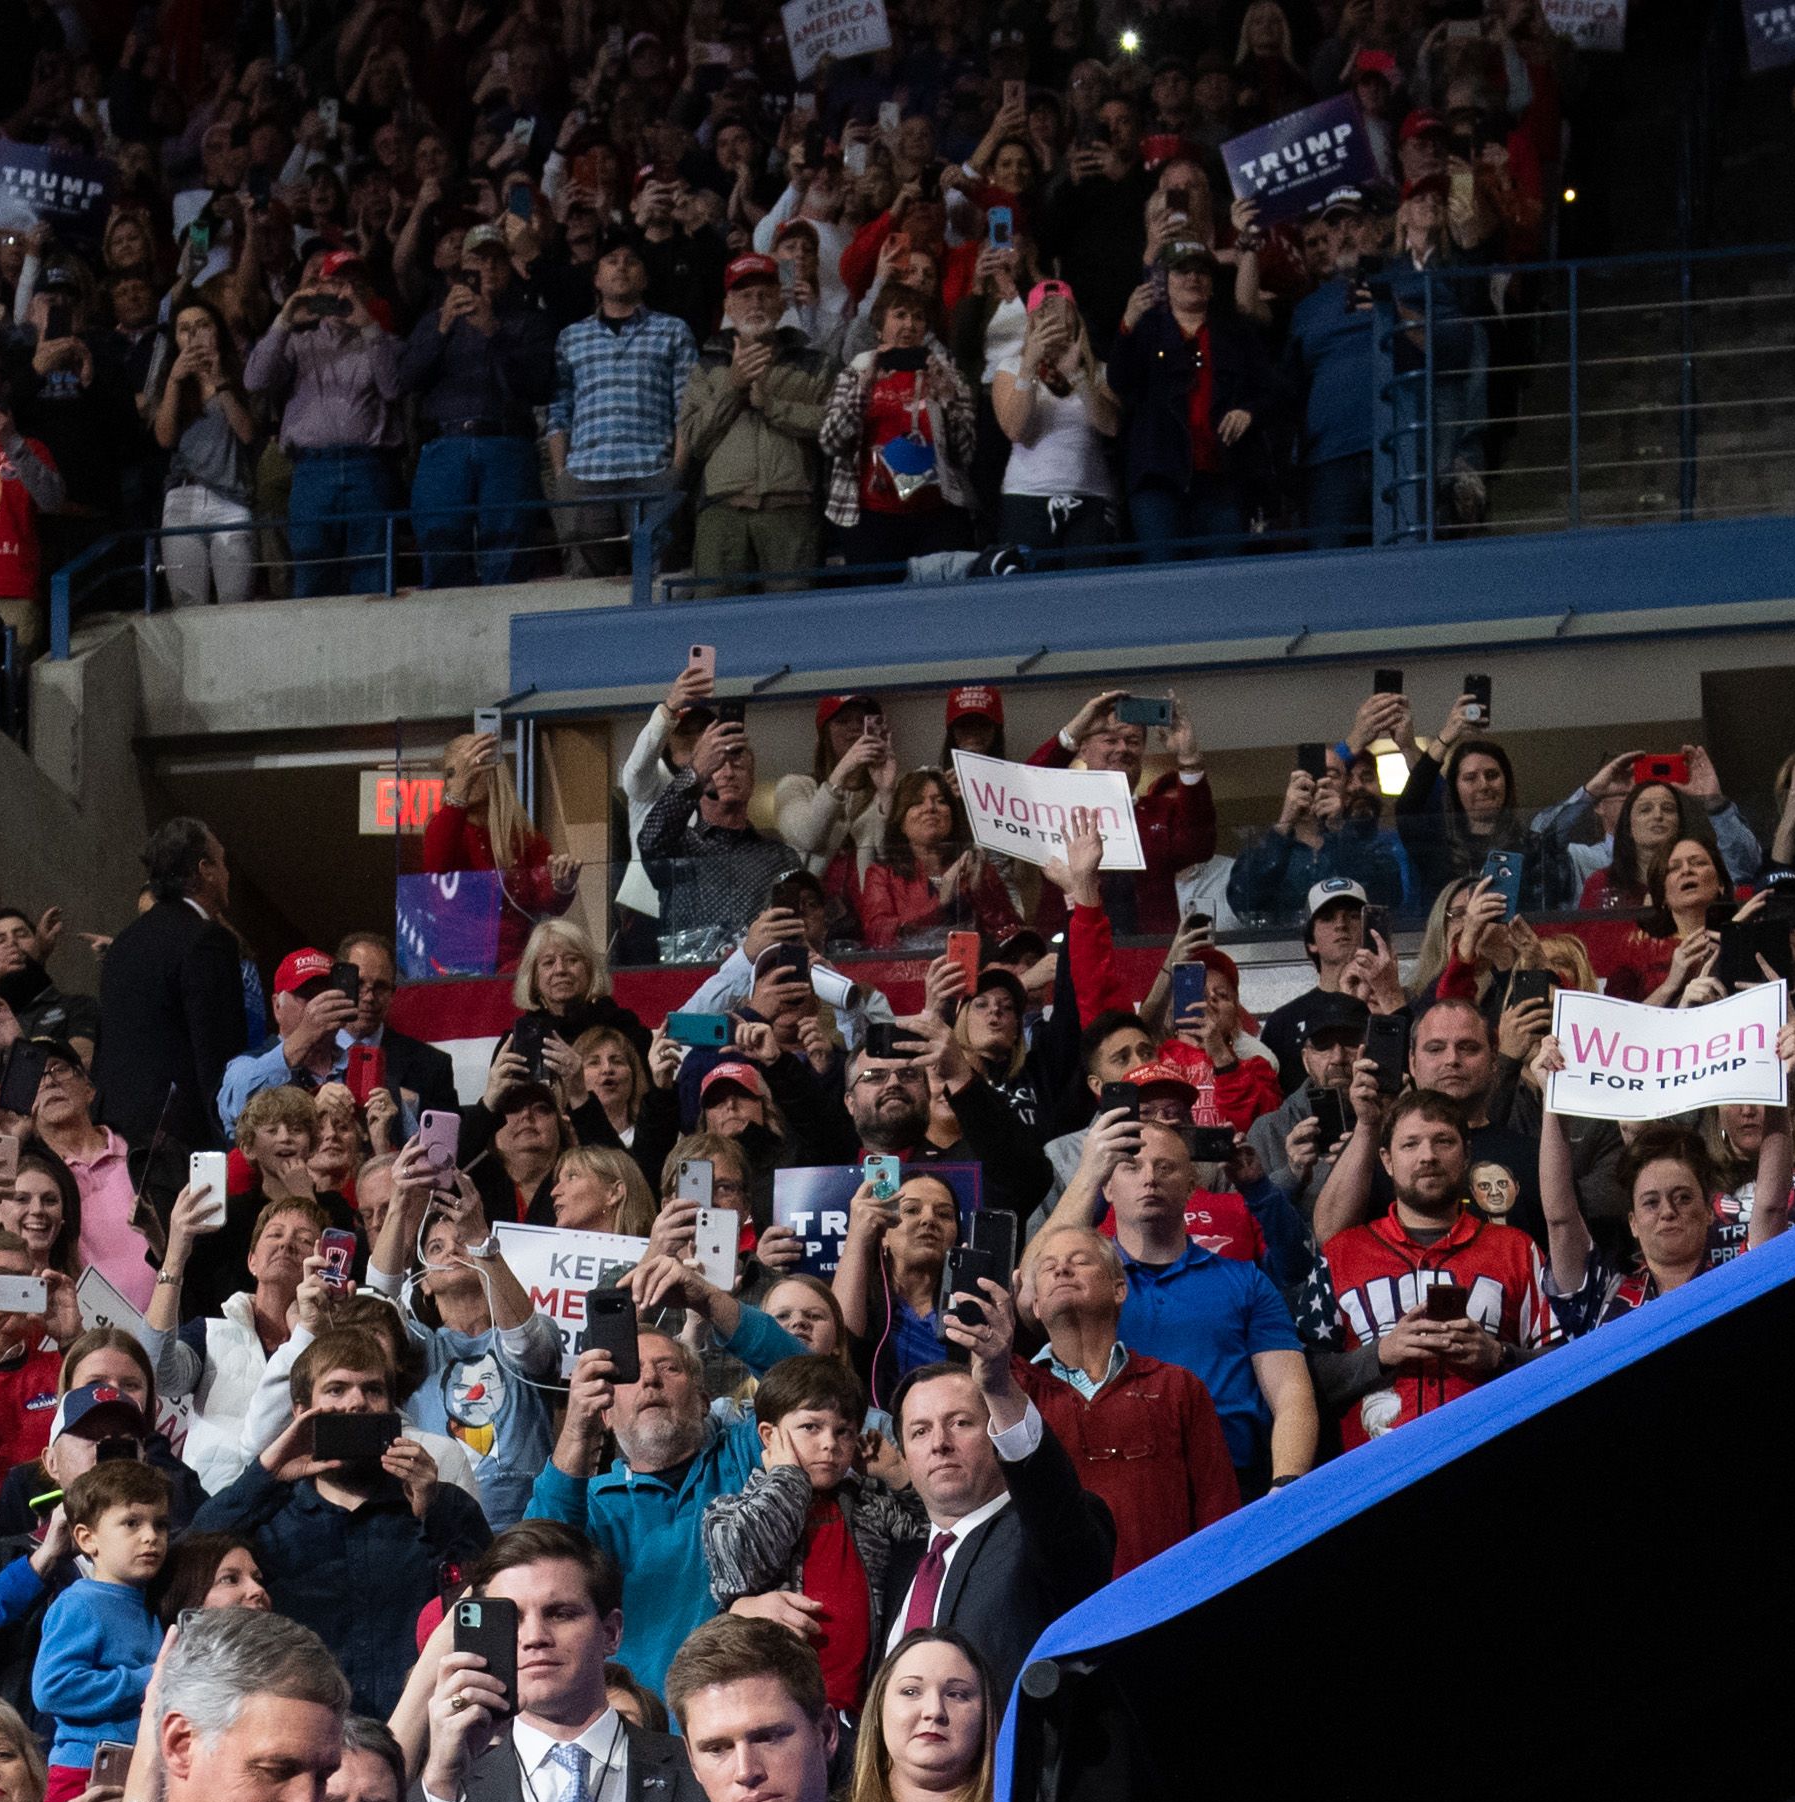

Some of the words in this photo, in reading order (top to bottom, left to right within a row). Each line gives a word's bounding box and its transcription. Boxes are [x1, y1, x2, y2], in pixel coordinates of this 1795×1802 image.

[794, 3, 879, 45] AMERICA
[1240, 122, 1353, 183] TRUMP
[1254, 146, 1349, 191] PENCE
[2, 164, 105, 198] TRUMP
[8, 185, 93, 211] PENCE
[376, 777, 446, 827] EXIT
[992, 818, 1032, 839] FOR
[1568, 1021, 1767, 1074] Women
[1589, 1075, 1645, 1094] FOR
[1656, 1055, 1748, 1090] TRUMP
